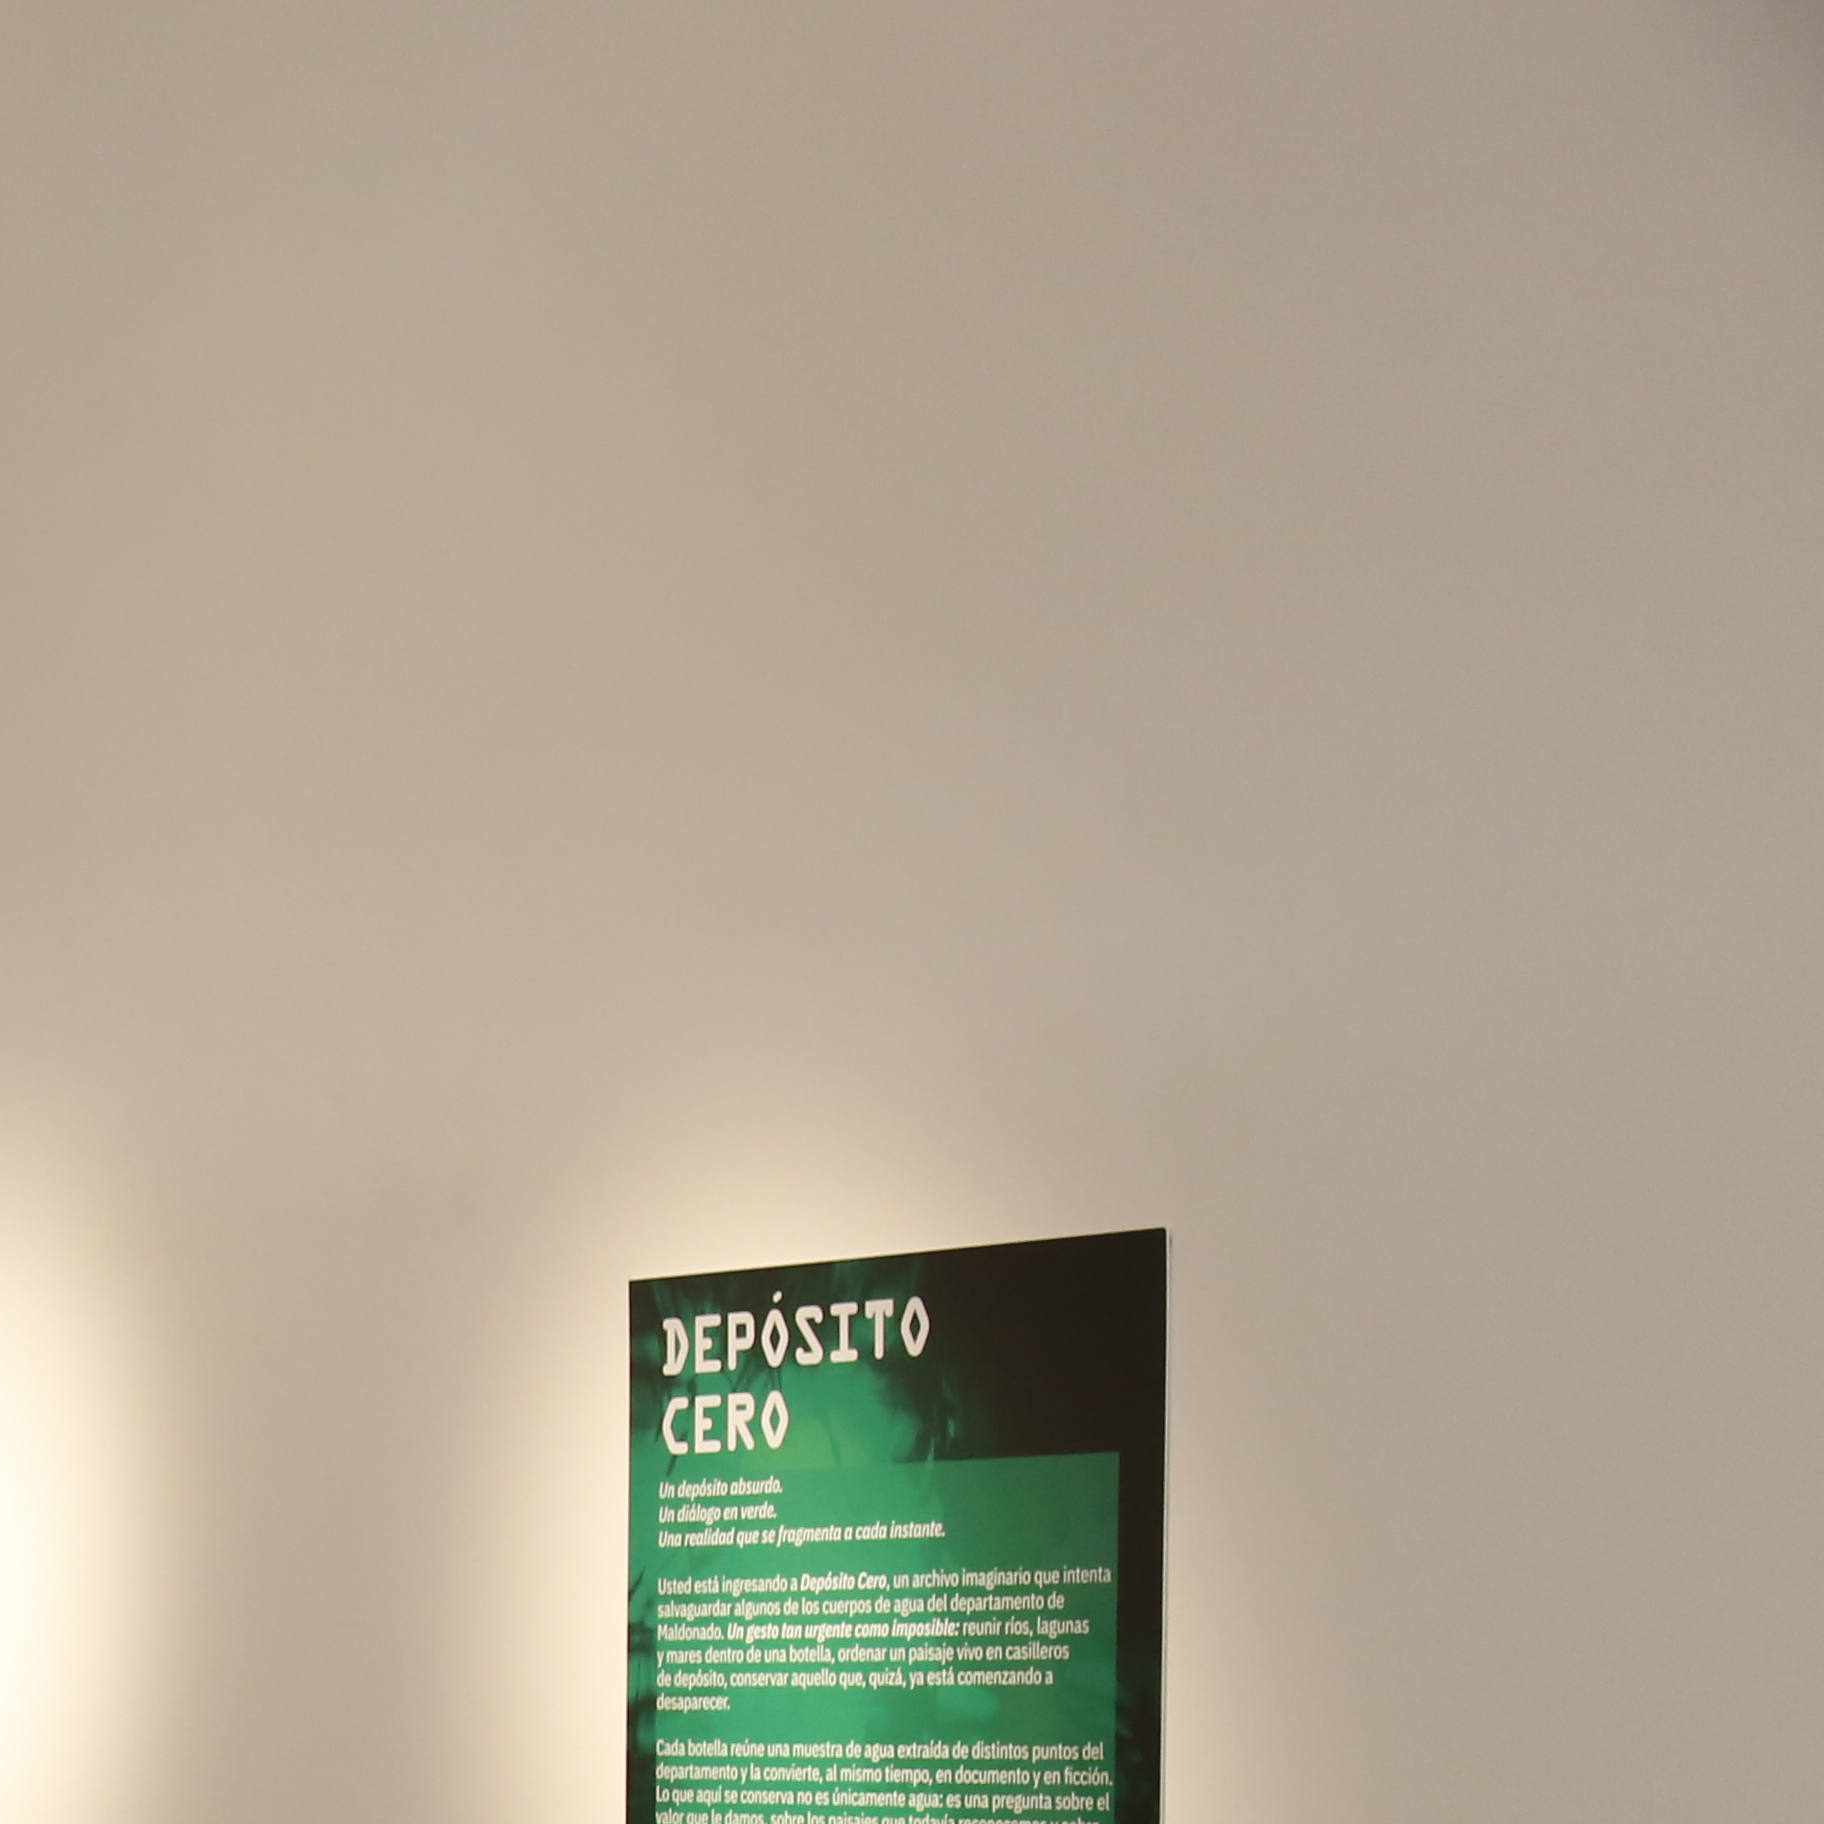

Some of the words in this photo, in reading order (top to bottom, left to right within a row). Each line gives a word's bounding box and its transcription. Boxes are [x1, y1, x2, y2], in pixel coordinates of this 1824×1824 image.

[662, 1291, 930, 1377] DEPÓSITO
[661, 1390, 789, 1456] CERO
[659, 1481, 676, 1498] Un
[677, 1479, 728, 1501] depósito
[730, 1476, 783, 1495] absurdo.
[659, 1505, 675, 1522] Un
[677, 1504, 721, 1525] diálogo
[723, 1506, 738, 1521] en
[740, 1501, 777, 1519] verde.
[658, 1530, 682, 1547] Una
[685, 1527, 734, 1547] realidad
[736, 1528, 759, 1547] que
[761, 1528, 775, 1543] se
[778, 1525, 842, 1546] fragmenta
[844, 1526, 853, 1541] a
[855, 1522, 887, 1540] cada
[890, 1521, 946, 1539] instante.
[658, 1575, 693, 1594] Usted
[694, 1574, 720, 1593] está
[722, 1573, 789, 1596] ingresando
[790, 1576, 799, 1591] a
[800, 1571, 857, 1594] Depósito
[857, 1571, 891, 1591] Cero,
[893, 1574, 910, 1588] un
[912, 1569, 960, 1588] archivo
[962, 1567, 1032, 1589] imaginario
[1034, 1570, 1061, 1588] que
[1064, 1565, 1112, 1584] intenta
[658, 1599, 733, 1621] salvaguardar
[734, 1598, 782, 1620] algunos
[783, 1597, 800, 1616] de
[802, 1597, 821, 1615] los
[822, 1600, 873, 1618] cuerpos
[874, 1595, 892, 1614] de
[893, 1599, 925, 1617] agua
[927, 1594, 948, 1613] del
[950, 1594, 1045, 1616] departamento
[1047, 1592, 1066, 1611] de
[658, 1622, 725, 1642] Maldonado.
[727, 1622, 745, 1641] Un
[746, 1623, 780, 1644] gesto
[781, 1623, 804, 1640] tan
[804, 1622, 854, 1643] urgente
[854, 1624, 891, 1639] como
[891, 1619, 961, 1641] imposible:
[963, 1618, 1003, 1637] reunir
[1005, 1618, 1034, 1639] ríos,
[1037, 1617, 1090, 1639] lagunas
[657, 1651, 665, 1669] y
[666, 1650, 704, 1665] mares
[705, 1646, 745, 1665] dentro
[746, 1646, 763, 1664] de
[764, 1649, 788, 1664] una
[789, 1645, 836, 1666] botella,
[838, 1644, 888, 1663] ordenar
[890, 1648, 907, 1662] un
[909, 1643, 955, 1666] paisaje
[957, 1643, 984, 1662] vivo
[986, 1647, 1004, 1661] en
[1005, 1642, 1070, 1661] casilleros
[657, 1671, 673, 1689] de
[674, 1671, 729, 1693] depósito,
[730, 1674, 790, 1689] conservar
[791, 1670, 838, 1692] aquello
[839, 1674, 867, 1692] que,
[869, 1669, 908, 1692] quizá,
[909, 1673, 925, 1691] ya
[927, 1669, 956, 1688] está
[957, 1668, 1043, 1687] comenzando
[1045, 1672, 1054, 1687] a
[657, 1693, 731, 1715] desaparecer.
[656, 1762, 739, 1785] departamento
[740, 1767, 749, 1785] y
[750, 1764, 762, 1782] la
[763, 1764, 824, 1786] convierte,
[826, 1765, 838, 1783] al
[840, 1765, 884, 1784] mismo
[885, 1765, 934, 1788] tiempo,
[936, 1770, 953, 1785] en
[955, 1766, 1031, 1786] documento
[1033, 1771, 1042, 1789] y
[1044, 1771, 1062, 1786] en
[1064, 1768, 1114, 1787] ficción.
